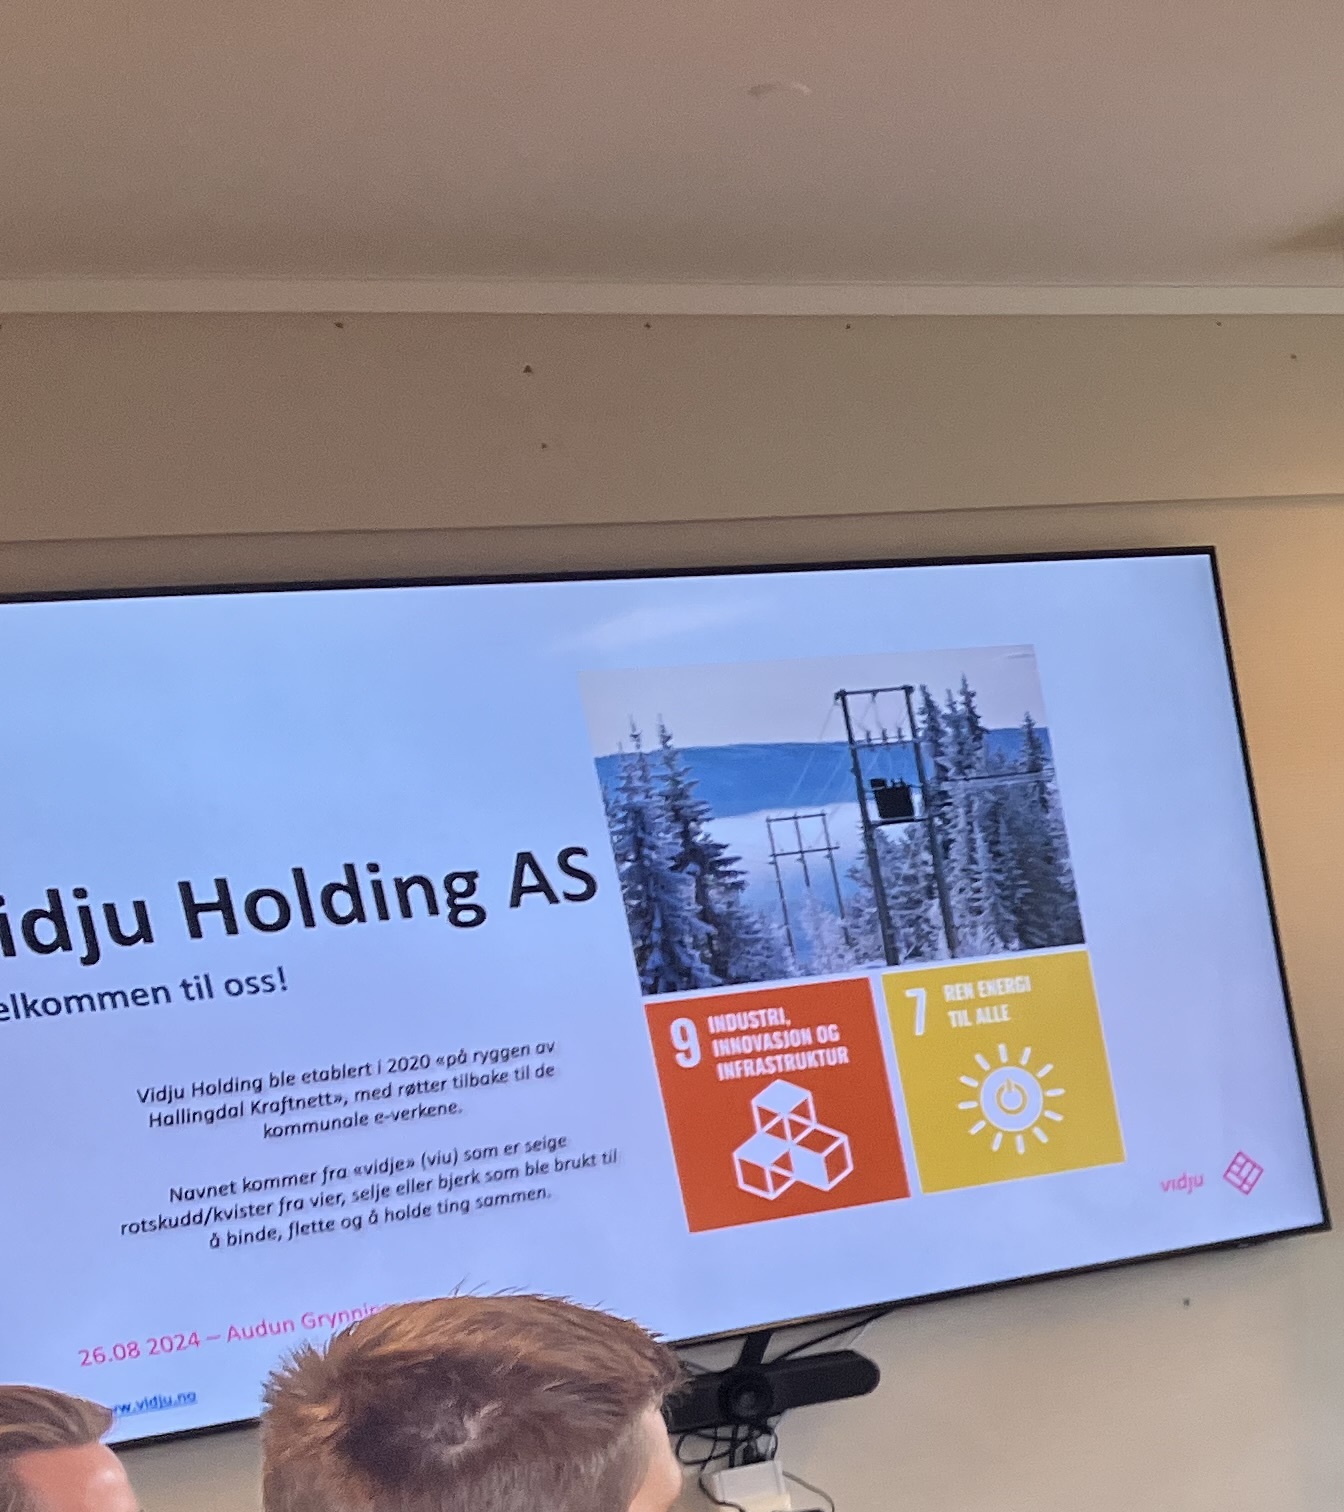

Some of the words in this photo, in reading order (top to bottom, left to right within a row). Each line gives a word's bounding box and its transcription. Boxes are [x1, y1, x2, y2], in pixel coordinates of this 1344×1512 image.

[0, 887, 154, 966] idju
[178, 863, 487, 939] Holding
[509, 847, 598, 908] AS
[0, 983, 172, 1022] elkommen
[179, 972, 214, 1001] til
[224, 966, 289, 997] oss!
[905, 987, 927, 1036] 7
[944, 982, 976, 1002] REN
[977, 975, 1032, 998] ENERGI
[948, 1009, 973, 1028] TIL
[976, 1004, 1011, 1025] ALLE
[670, 1017, 701, 1069] 9
[707, 1006, 791, 1034] INDUSTRI,
[712, 1027, 813, 1057] INNOVASJON
[816, 1024, 841, 1043] OG
[717, 1046, 850, 1081] INFRASTRUKTUR
[136, 1084, 185, 1104] Vidju
[191, 1076, 263, 1098] Holding
[269, 1069, 296, 1088] ble
[301, 1062, 372, 1084] etablert
[387, 1053, 431, 1074] 2020
[436, 1048, 467, 1069] «på
[472, 1043, 531, 1065] ryggen
[535, 1041, 556, 1054] av
[149, 1101, 244, 1128] Hallingdal
[250, 1091, 349, 1116] Kraftnett»,
[355, 1082, 392, 1102] med
[398, 1077, 447, 1097] røtter
[452, 1069, 509, 1090] tilbake
[514, 1065, 530, 1082] til
[535, 1062, 555, 1079] de
[263, 1112, 369, 1139] kommunale
[374, 1101, 463, 1125] e-verkene.
[120, 1200, 274, 1236] rotskudd/kvister
[278, 1196, 304, 1217] fra
[309, 1192, 346, 1208] vier,
[351, 1183, 390, 1202] selje
[396, 1176, 433, 1195] eller
[438, 1168, 481, 1192] bjerk
[485, 1166, 519, 1183] som
[525, 1160, 549, 1177] ble
[554, 1151, 597, 1173] brukt
[601, 1147, 618, 1165] til
[169, 1180, 236, 1203] Navnet
[242, 1170, 317, 1193] kommer
[321, 1165, 348, 1186] fra
[353, 1156, 415, 1177] «vidje»
[421, 1147, 458, 1170] (viu)
[463, 1146, 498, 1162] som
[503, 1142, 521, 1156] er
[524, 1135, 567, 1154] seige
[1160, 1171, 1204, 1195] vidju
[209, 1232, 221, 1249] å
[227, 1225, 283, 1247] binde,
[287, 1217, 335, 1242] flette
[341, 1215, 363, 1231] og
[368, 1209, 379, 1226] å
[384, 1203, 432, 1224] holde
[437, 1197, 470, 1215] ting
[475, 1187, 551, 1210] sammen.
[78, 1341, 141, 1368] 26.08
[147, 1331, 200, 1357] 2024
[226, 1320, 295, 1343] Audun
[113, 1390, 198, 1416] w.vidju.no
